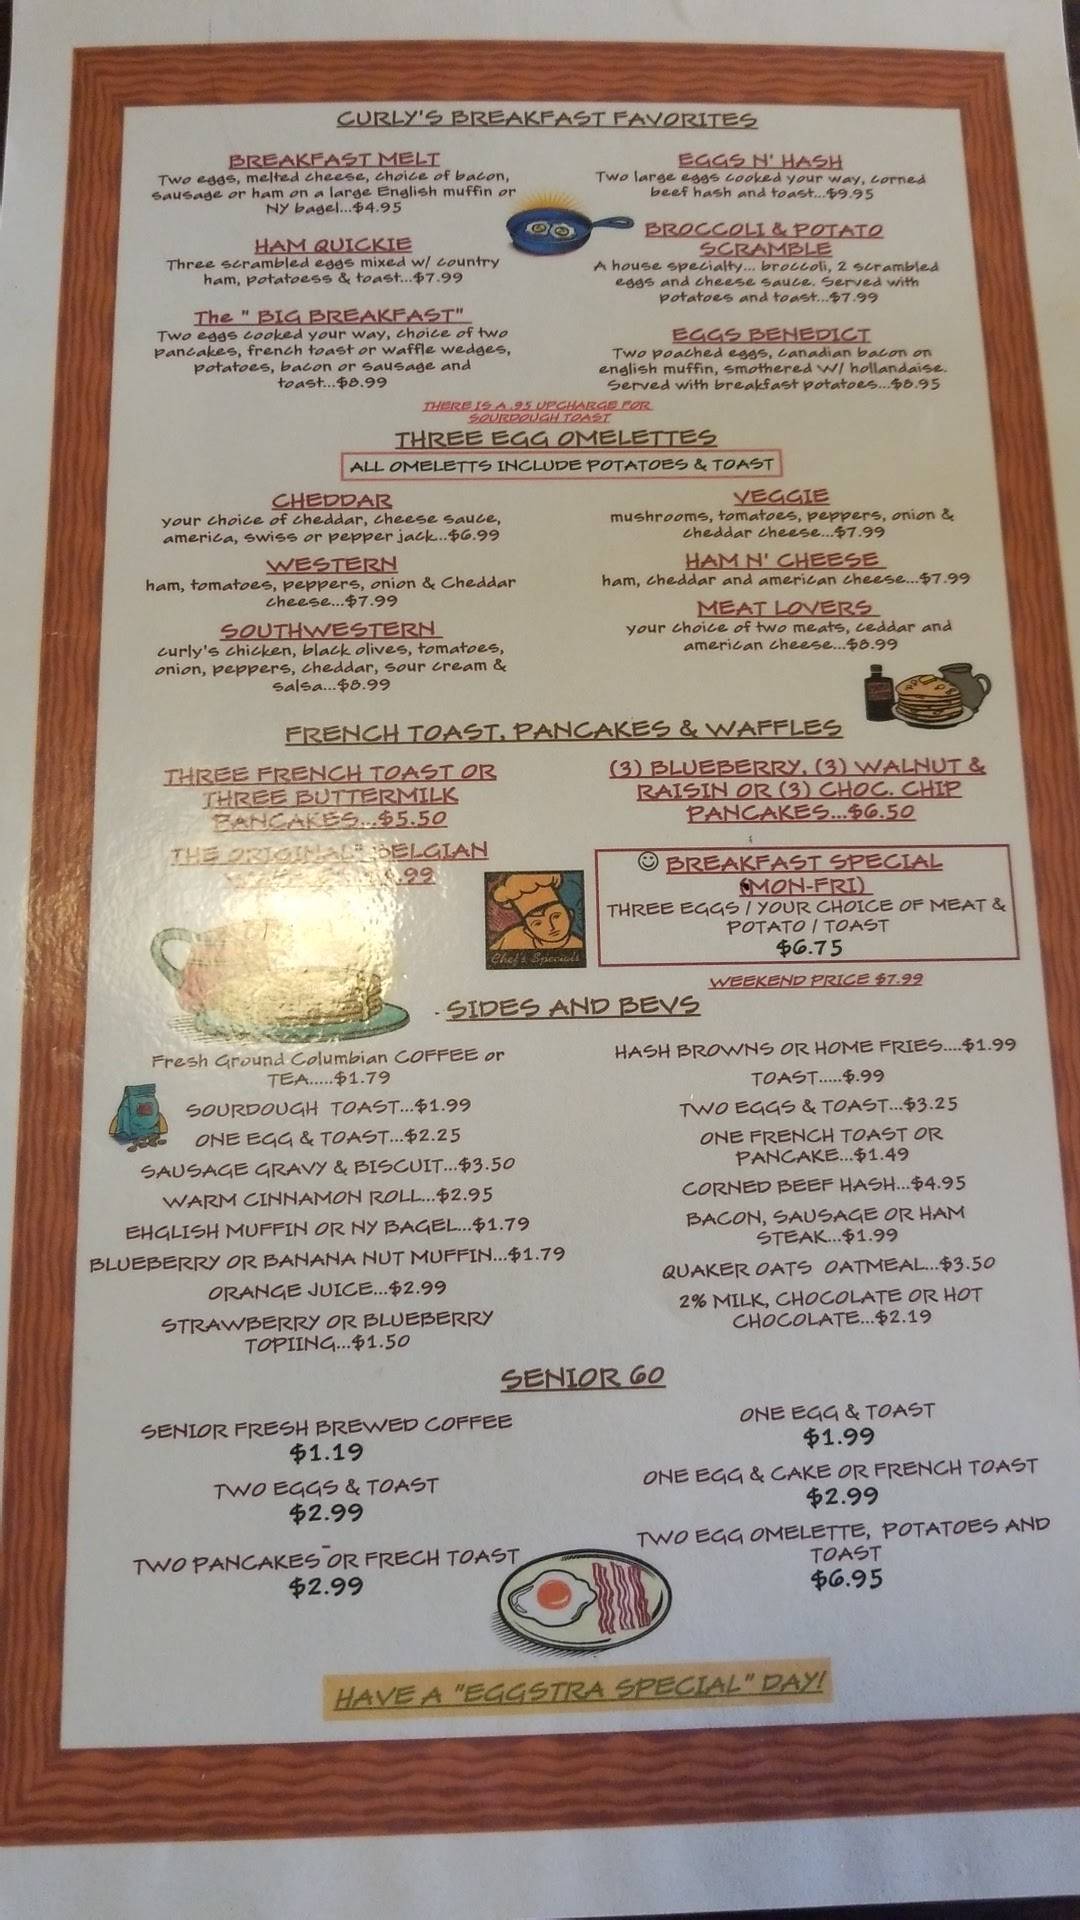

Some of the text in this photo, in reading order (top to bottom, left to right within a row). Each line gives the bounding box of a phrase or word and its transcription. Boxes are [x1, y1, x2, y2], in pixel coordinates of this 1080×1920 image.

[337, 111, 758, 128] CURLY'S BREAKFAST FAVORITES
[229, 152, 440, 168] BREAKFAST MELT
[679, 153, 843, 169] EGGS N' HASH
[651, 186, 688, 197] beef
[693, 186, 731, 198] hash
[737, 187, 766, 198] and
[266, 203, 289, 215] NY
[645, 222, 884, 238] BROCCOLI & POTATO
[254, 238, 413, 253] HAM QUICKIE
[700, 242, 832, 256] SCRAMBLE
[204, 273, 240, 286] ham,
[246, 273, 332, 286] potatoess
[338, 272, 351, 285] &
[659, 291, 733, 304] potatoes
[739, 291, 768, 303] and
[194, 310, 233, 325] The
[258, 309, 301, 324] BIG
[309, 308, 464, 323] BREAKFAST"
[672, 328, 872, 343] EGGS BENEDICT
[607, 379, 670, 391] Served
[675, 379, 708, 390] with
[715, 378, 800, 391] breakfast
[423, 400, 650, 411] THERE IS A .95 UPCHARGE FOR
[468, 412, 612, 423] SOURDOUGH TOAST
[395, 429, 717, 448] THREE EGG OMELETTES
[350, 456, 775, 475] ALL OMELETTS INCLUDE POTATOES & TOAST
[271, 492, 393, 509] CHEDDAR
[733, 488, 830, 505] VEGGIE
[163, 531, 238, 545] america,
[244, 531, 298, 543] swiss
[304, 533, 323, 543] or
[329, 531, 393, 544] pepper
[683, 526, 752, 538] cheddar
[266, 556, 399, 573] WESTERN
[685, 552, 883, 569] HAM N' CHEESE
[697, 600, 872, 617] MEAT LOVERS
[220, 621, 436, 639] SOUTHWESTERN
[683, 639, 763, 651] american
[286, 725, 399, 744] FRENCH
[515, 721, 670, 741] PANCAKES
[679, 721, 698, 738] &
[705, 719, 842, 737] WAFFLES
[202, 787, 459, 808] THREE BUTTERMILK
[637, 780, 962, 800] RAISIN OR (3) CHOC. CHIP
[666, 853, 943, 873] BREAKFAST SPECIAL
[776, 938, 844, 958] $6.75
[708, 973, 924, 989] WEEKEND PRICE $7.99
[447, 995, 700, 1019] SIDES AND BEVS
[615, 1043, 671, 1059] HASH
[676, 1042, 774, 1059] BROWNS
[780, 1043, 810, 1057] OR
[815, 1040, 874, 1055] HOME
[184, 1100, 318, 1118] SOURDOUGH
[195, 1132, 240, 1148] ONE
[246, 1132, 293, 1148] EGG
[300, 1131, 314, 1147] &
[682, 1180, 772, 1197] CORNED
[777, 1178, 834, 1194] BEEF
[162, 1193, 237, 1210] WARM
[243, 1189, 362, 1208] CINNAMON
[226, 1221, 307, 1239] MUFFIN
[314, 1222, 346, 1237] OR
[351, 1220, 378, 1236] NY
[662, 1262, 750, 1280] QUAKER
[756, 1260, 812, 1277] OATS
[208, 1283, 302, 1302] ORANGE
[501, 1365, 665, 1390] SENIOR 60
[140, 1414, 513, 1440] SENIOR FRESH BREWED COFFEE
[803, 1427, 875, 1449] $1.99
[289, 1443, 363, 1464] $1.19
[806, 1486, 878, 1509] $2.99
[289, 1502, 363, 1525] $2.99
[132, 1548, 520, 1575] TWO PANCAKES OR FRECH TOAST
[810, 1545, 882, 1564] TOAST
[288, 1576, 364, 1599] $2.99
[810, 1568, 883, 1591] $6.95
[333, 1670, 828, 1709] HAVE A "EGGSTRA SPECIAL" DAY!
